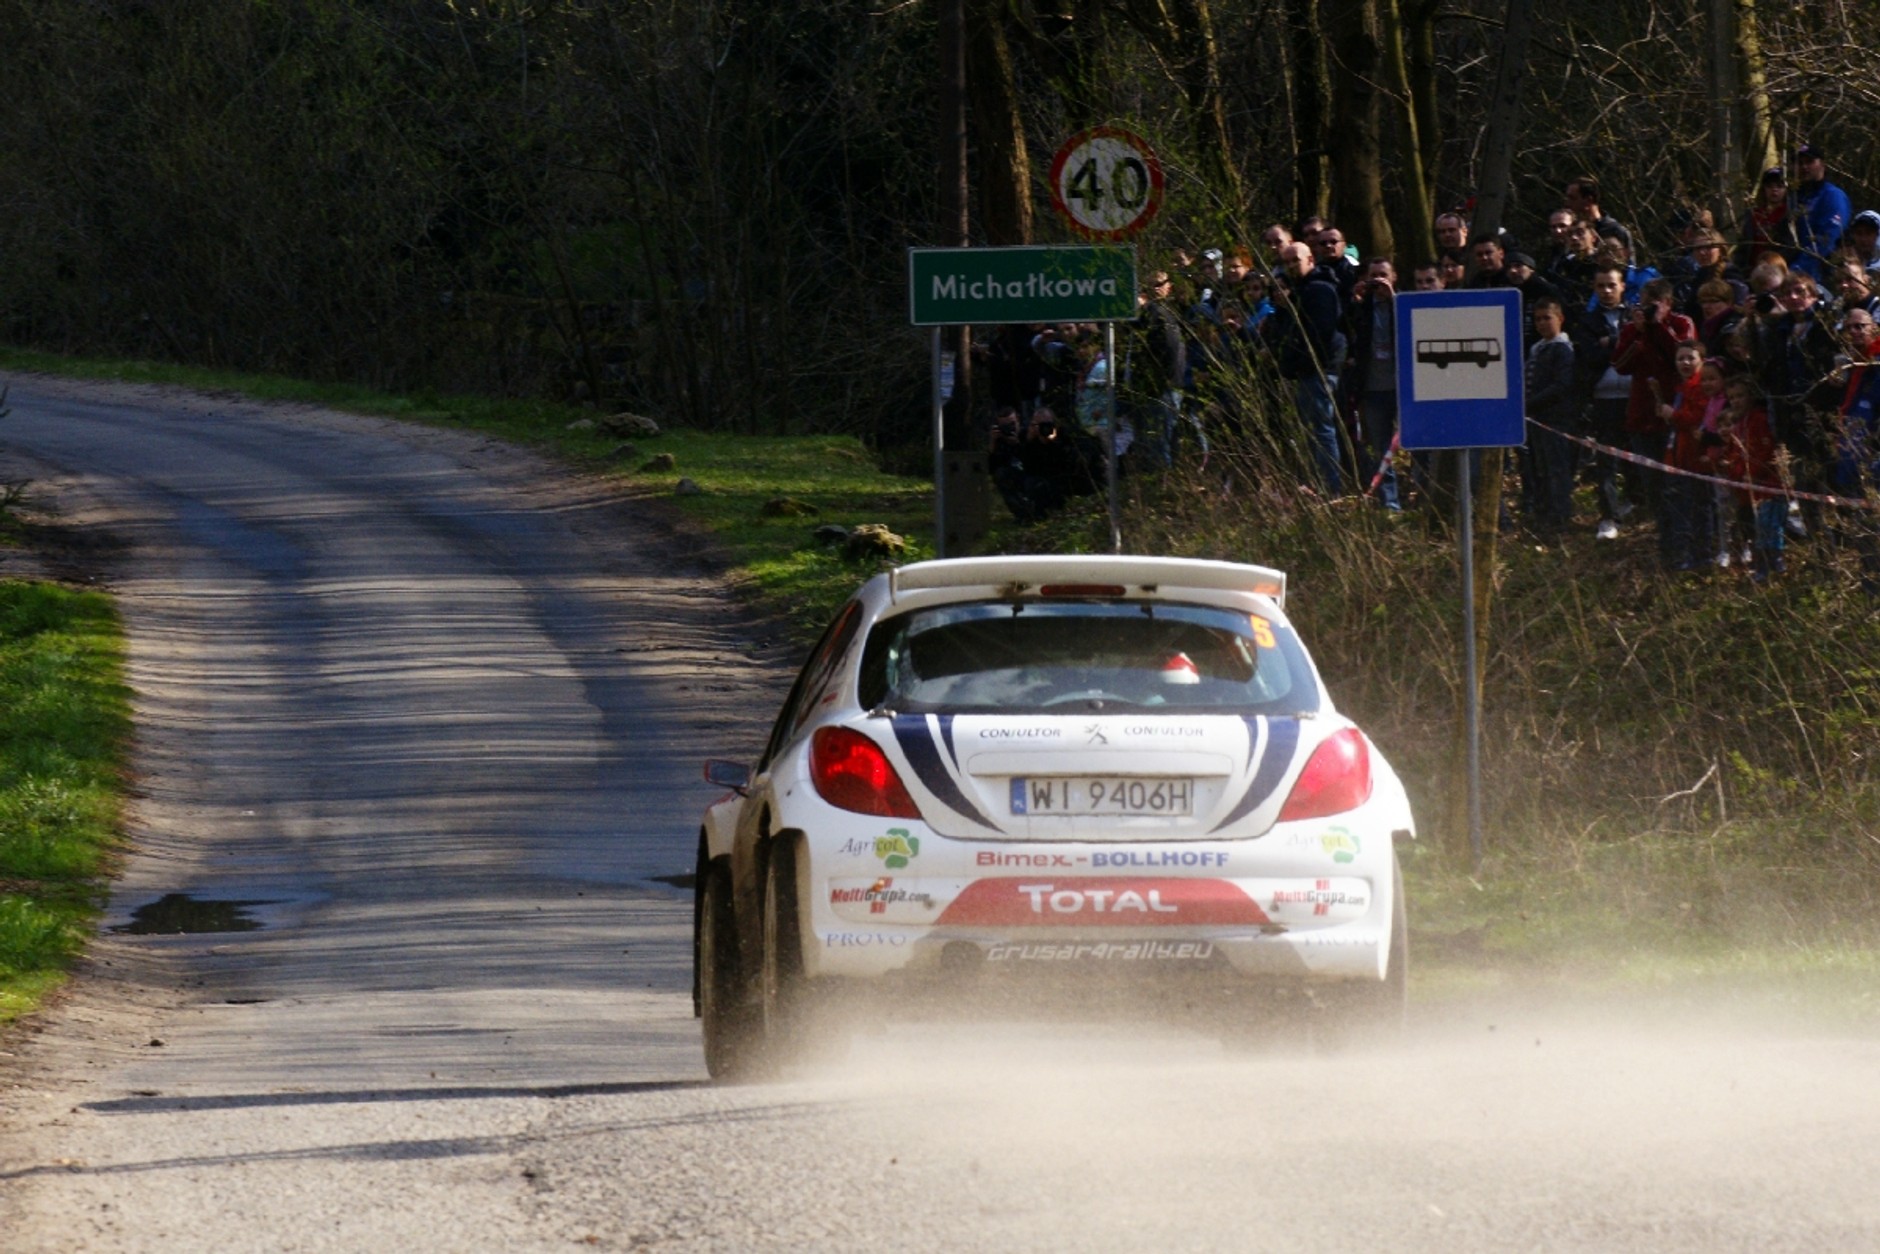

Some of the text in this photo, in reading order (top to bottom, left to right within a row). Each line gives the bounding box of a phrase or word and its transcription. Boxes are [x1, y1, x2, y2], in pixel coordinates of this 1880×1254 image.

[1067, 156, 1149, 212] 40
[932, 273, 1117, 301] Michałkowa
[1250, 614, 1276, 649] 5
[1031, 780, 1188, 811] WI 9406H
[1018, 884, 1178, 914] TOTAL
